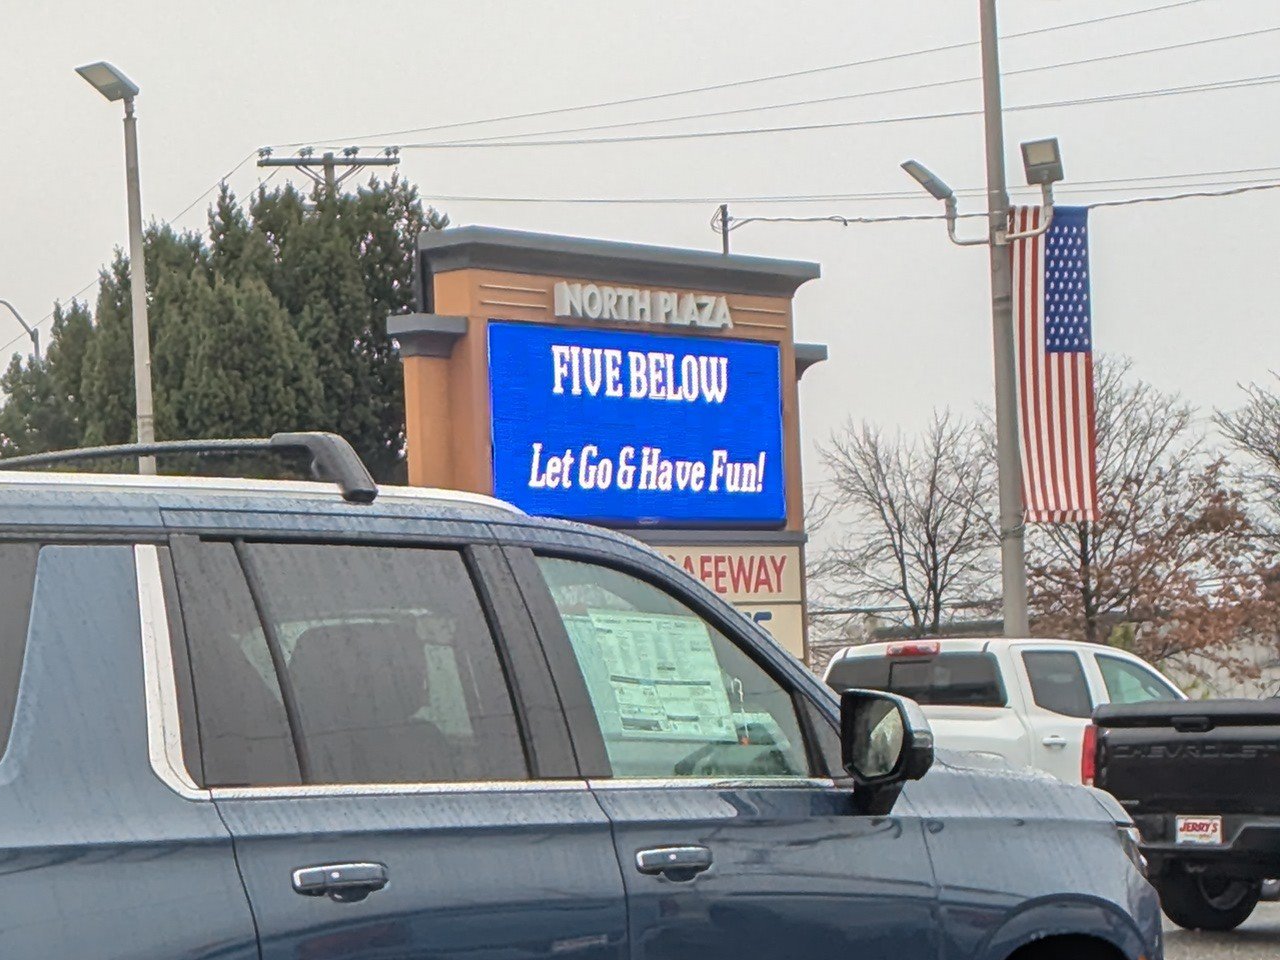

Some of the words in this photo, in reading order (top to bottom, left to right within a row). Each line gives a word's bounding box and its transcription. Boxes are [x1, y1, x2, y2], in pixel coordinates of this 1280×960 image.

[553, 281, 652, 322] NORTH
[651, 290, 734, 330] PLAZA
[551, 345, 623, 397] FIVE
[628, 351, 729, 403] BELOW
[528, 443, 574, 489] Let
[578, 444, 613, 490] Go
[617, 446, 637, 490] &
[638, 446, 706, 492] Have
[708, 450, 767, 493] Fun!
